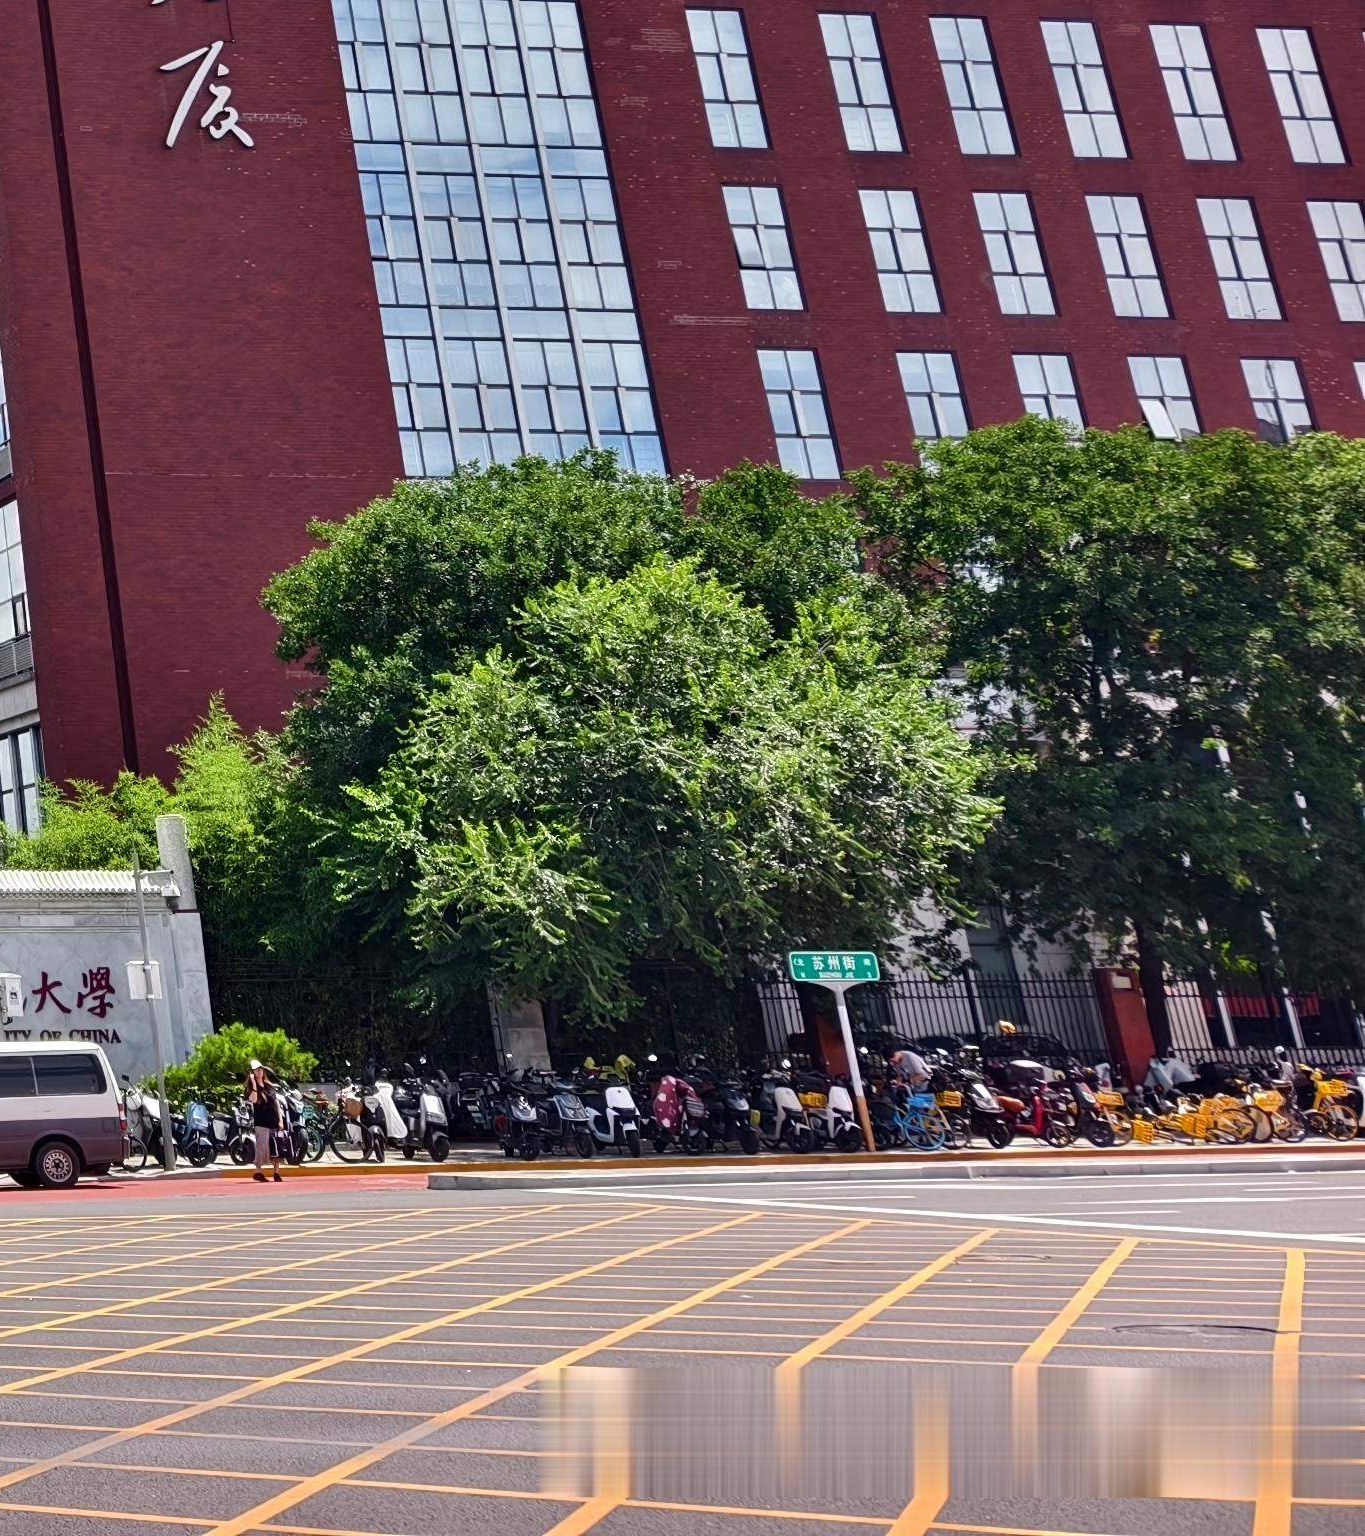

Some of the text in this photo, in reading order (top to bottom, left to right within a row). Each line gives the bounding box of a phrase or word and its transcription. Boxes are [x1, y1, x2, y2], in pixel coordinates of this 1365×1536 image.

[811, 955, 856, 971] 苏州街
[39, 1030, 62, 1042] OF
[68, 1029, 122, 1044] CHINA
